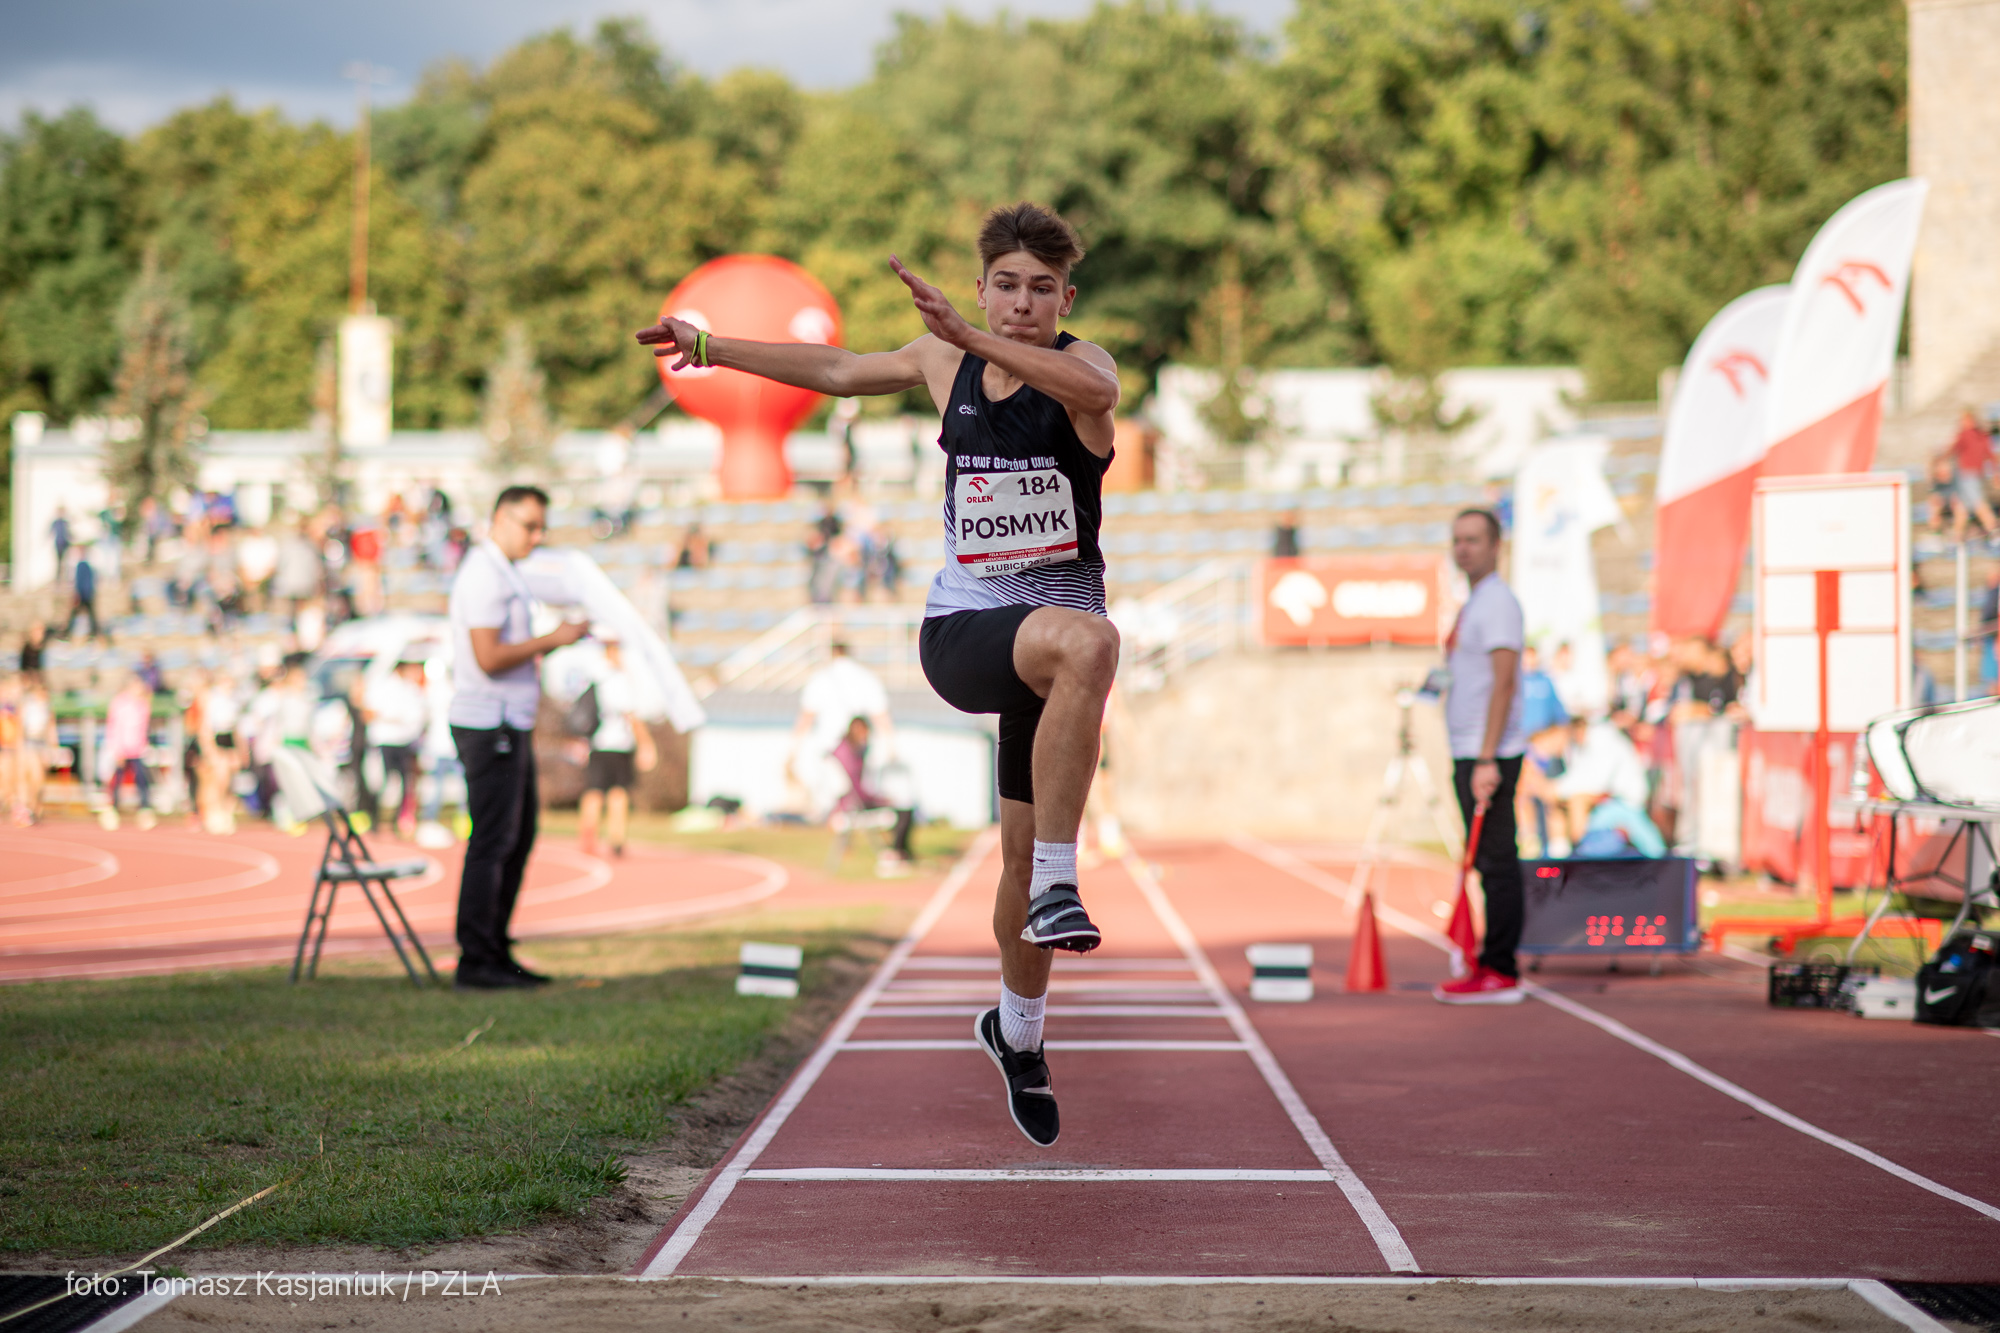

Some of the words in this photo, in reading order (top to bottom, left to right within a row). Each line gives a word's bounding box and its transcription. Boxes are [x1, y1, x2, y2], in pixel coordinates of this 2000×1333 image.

[956, 455, 971, 468] AZS
[972, 456, 991, 469] AWF
[1017, 474, 1061, 496] 184
[966, 495, 994, 504] ORLEN
[961, 509, 1070, 541] POSMYK
[985, 561, 1026, 573] SŁUBICE
[1027, 557, 1051, 567] 2023
